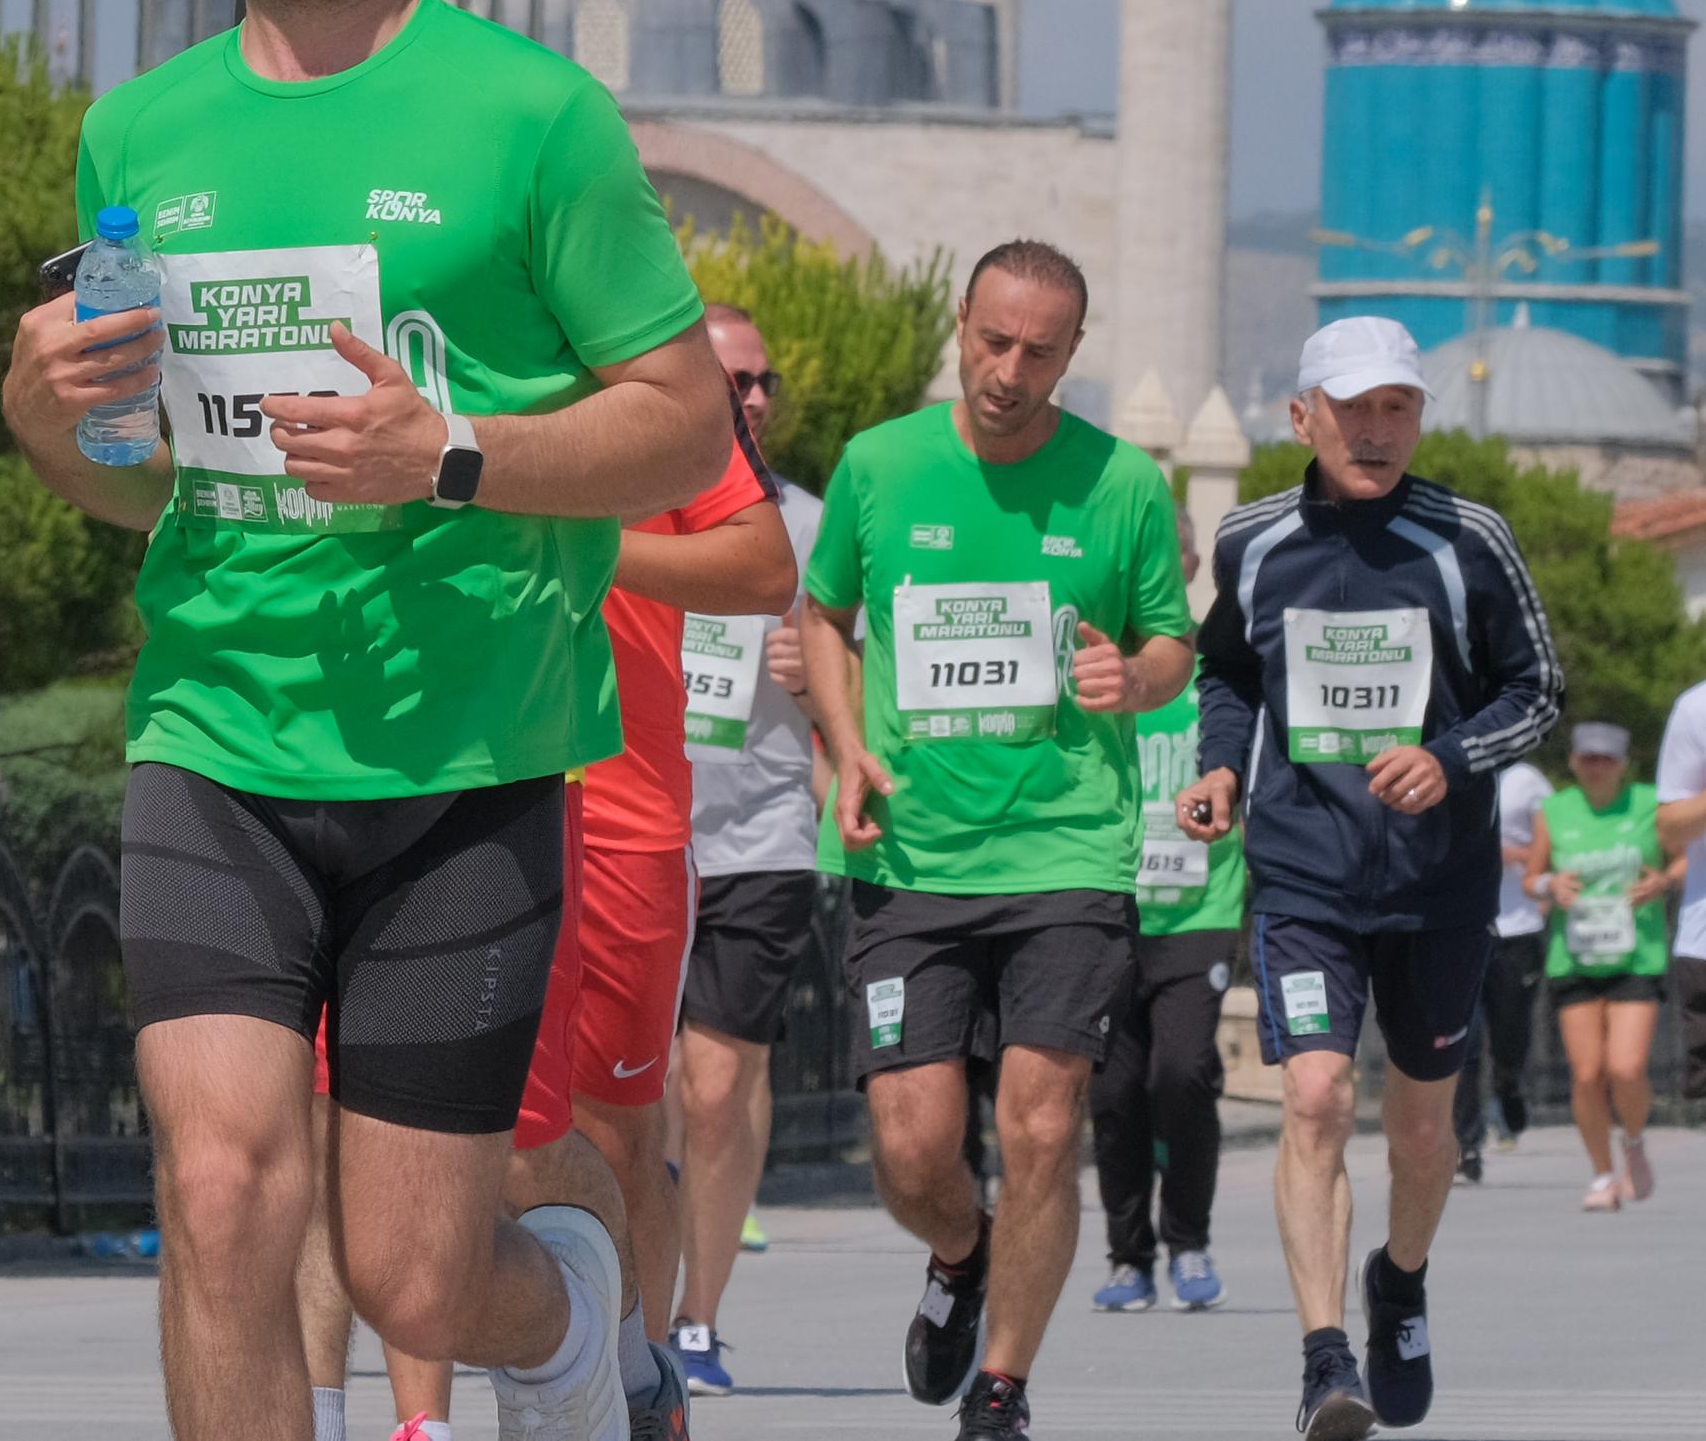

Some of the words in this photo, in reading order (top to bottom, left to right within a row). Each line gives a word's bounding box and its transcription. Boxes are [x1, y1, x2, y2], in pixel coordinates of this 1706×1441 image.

[366, 189, 427, 207] SPOR
[365, 202, 441, 224] KONYA
[200, 282, 302, 307] KONYA
[217, 306, 288, 327] YARI
[197, 390, 340, 439] 115
[940, 599, 1003, 612] KONYA
[951, 612, 993, 624] YARI
[919, 623, 1025, 638] MARATONU
[1326, 627, 1384, 640] KONYA
[1334, 640, 1375, 651] YARI
[1311, 649, 1406, 663] MARATONU
[930, 660, 1019, 687] 11031
[1321, 685, 1399, 709] 10311
[474, 949, 501, 1031] KIPSTA
